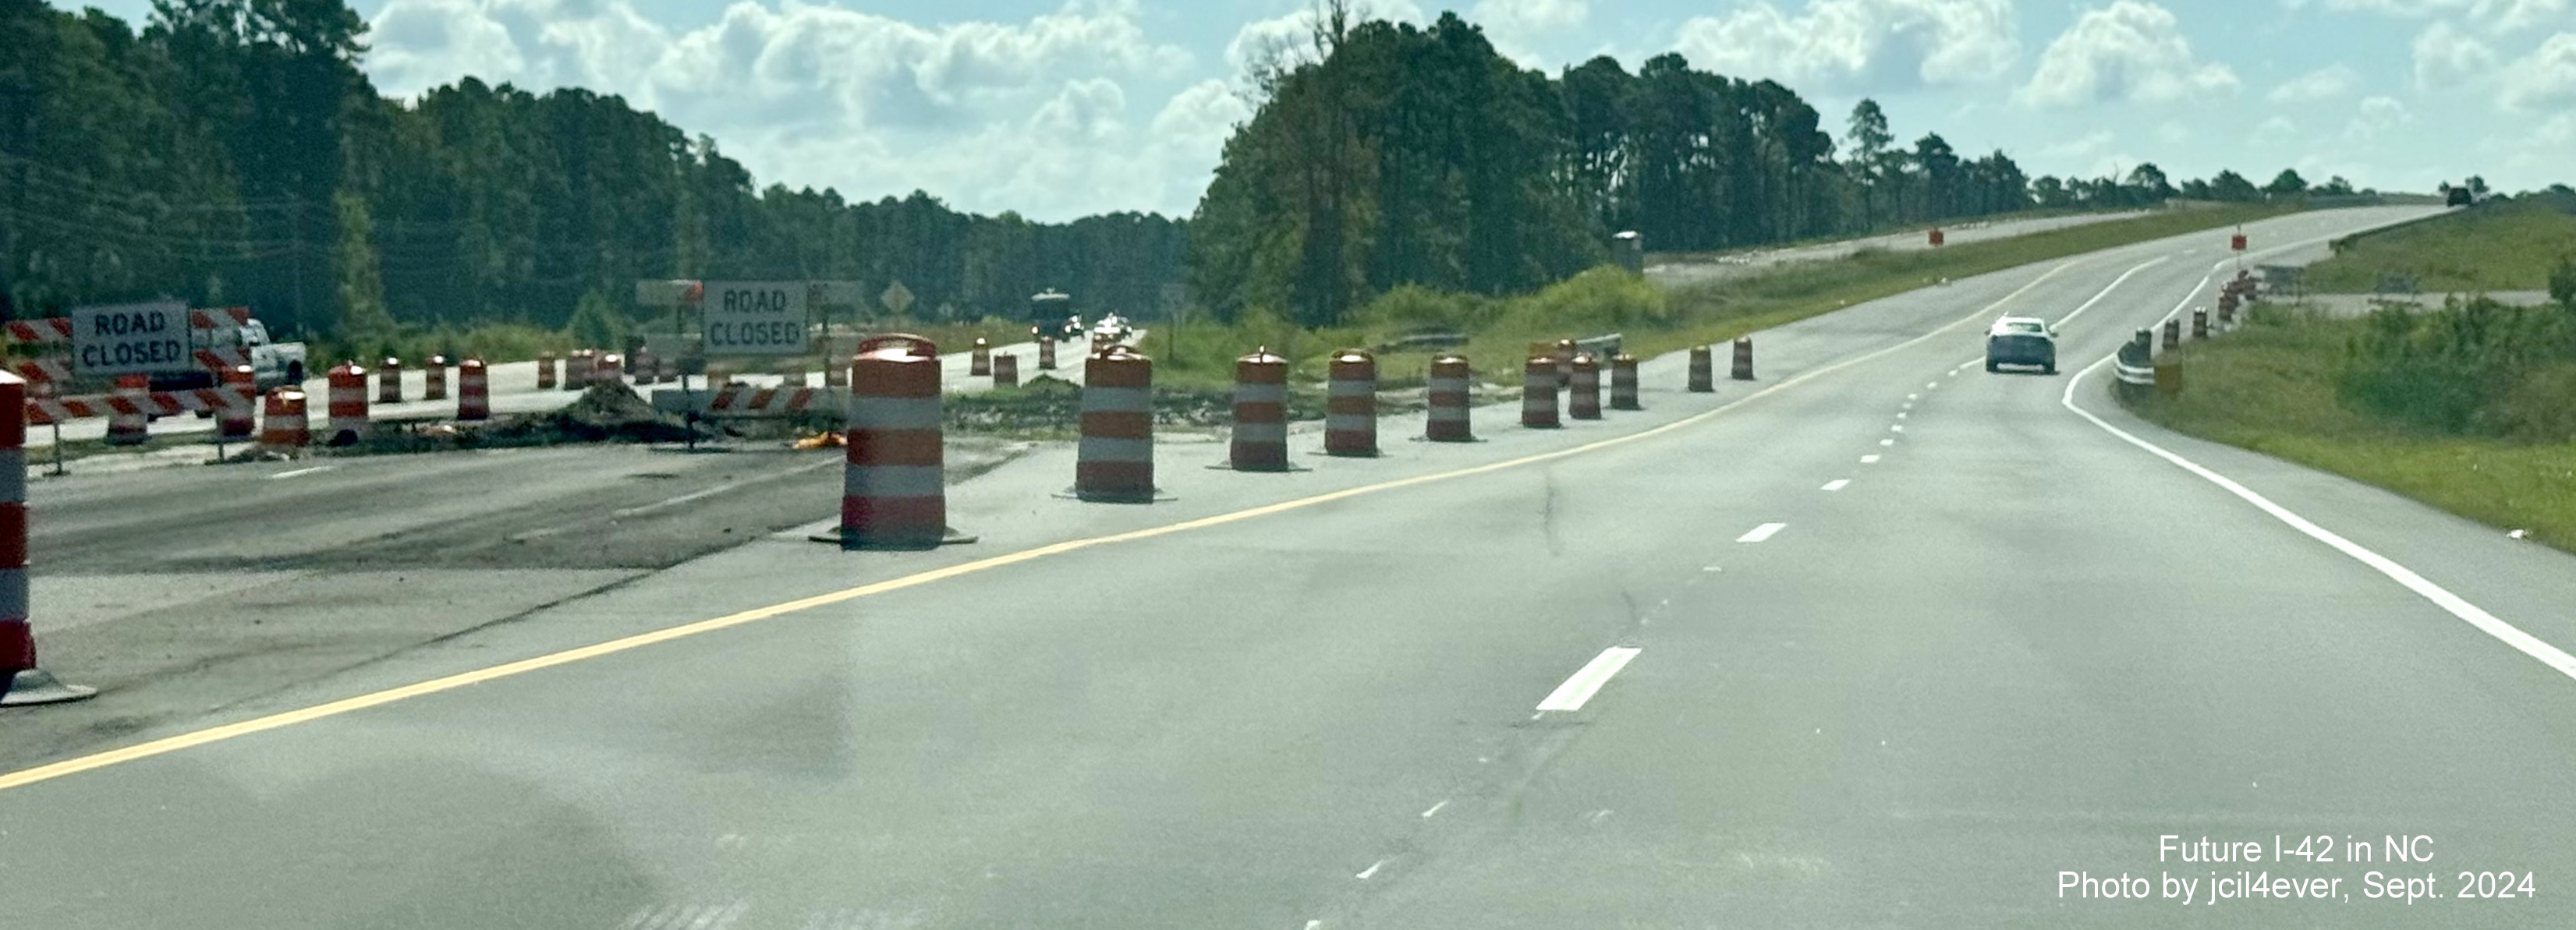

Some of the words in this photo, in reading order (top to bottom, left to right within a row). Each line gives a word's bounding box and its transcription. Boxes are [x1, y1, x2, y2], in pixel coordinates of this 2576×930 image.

[723, 288, 786, 312] ROAD
[95, 311, 165, 335] ROAD
[710, 321, 800, 346] CLOSED
[82, 339, 181, 367] CLOSED
